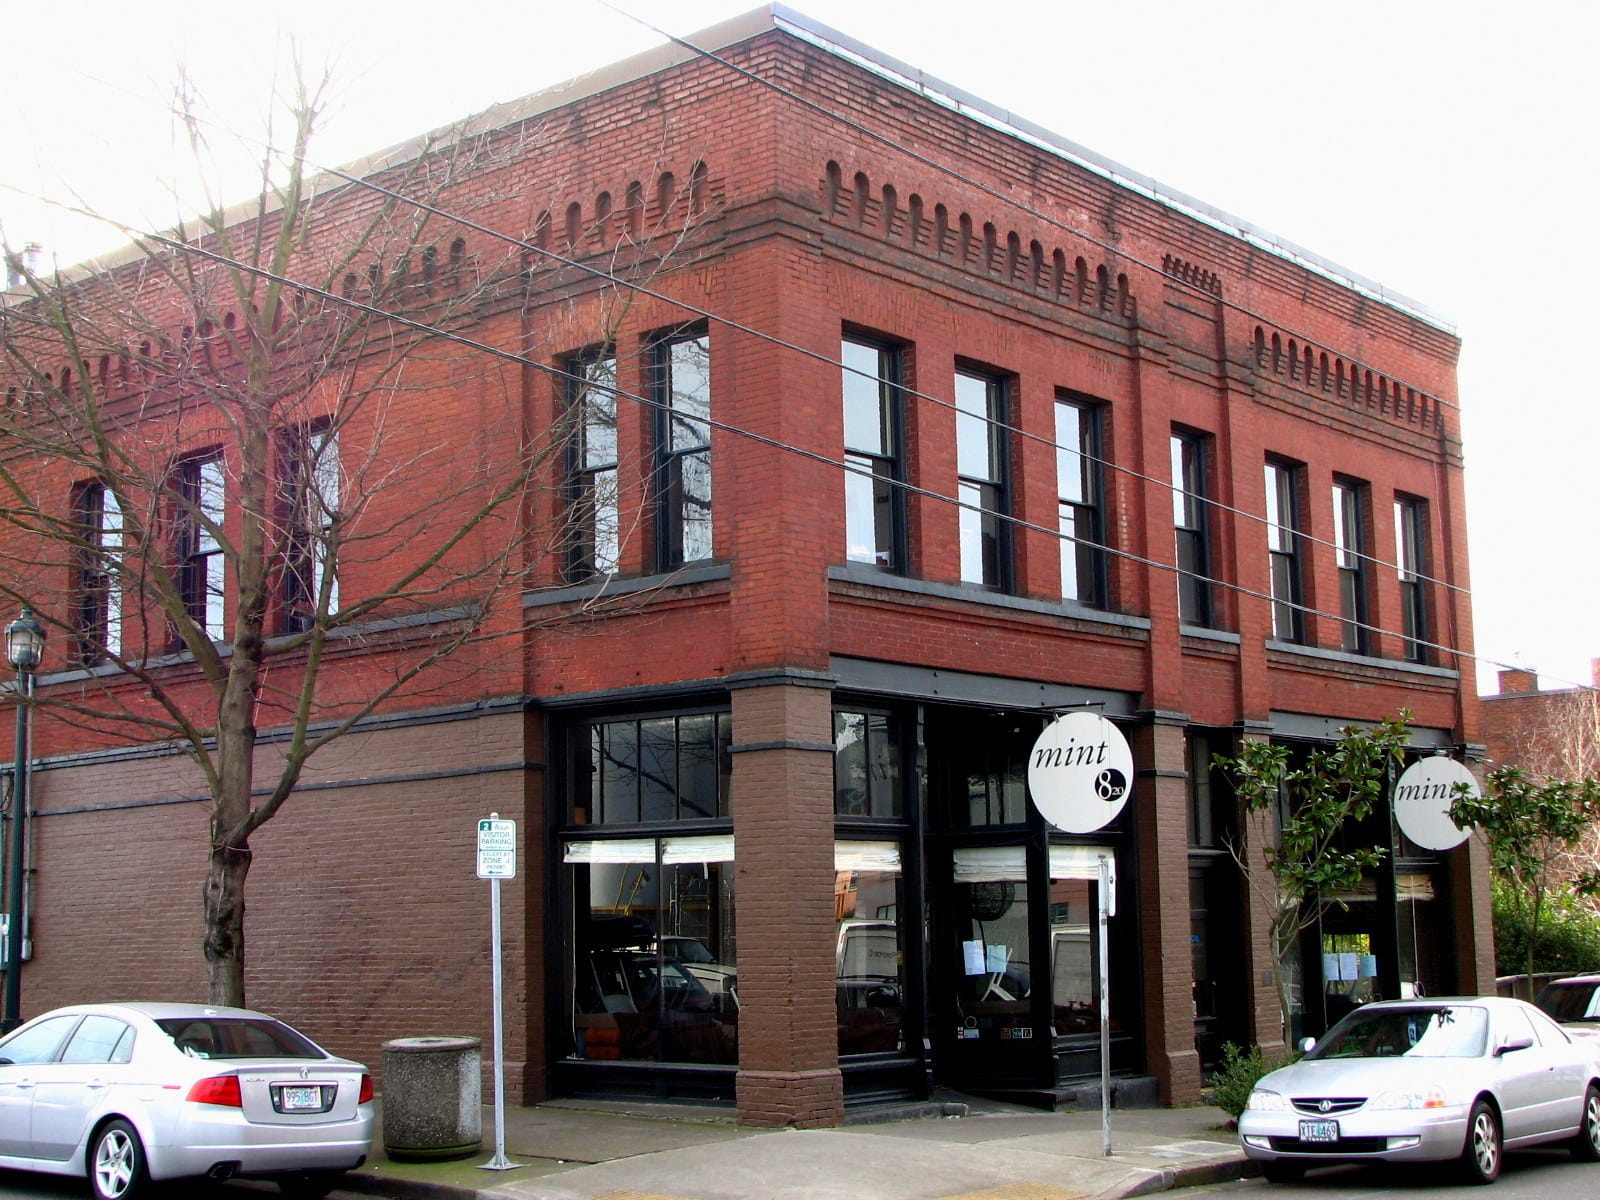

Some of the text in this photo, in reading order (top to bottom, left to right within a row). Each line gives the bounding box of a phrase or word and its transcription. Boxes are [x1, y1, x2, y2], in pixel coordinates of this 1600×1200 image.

[1035, 737, 1109, 769] mint
[483, 822, 490, 831] 2
[1320, 1125, 1336, 1137] 469
